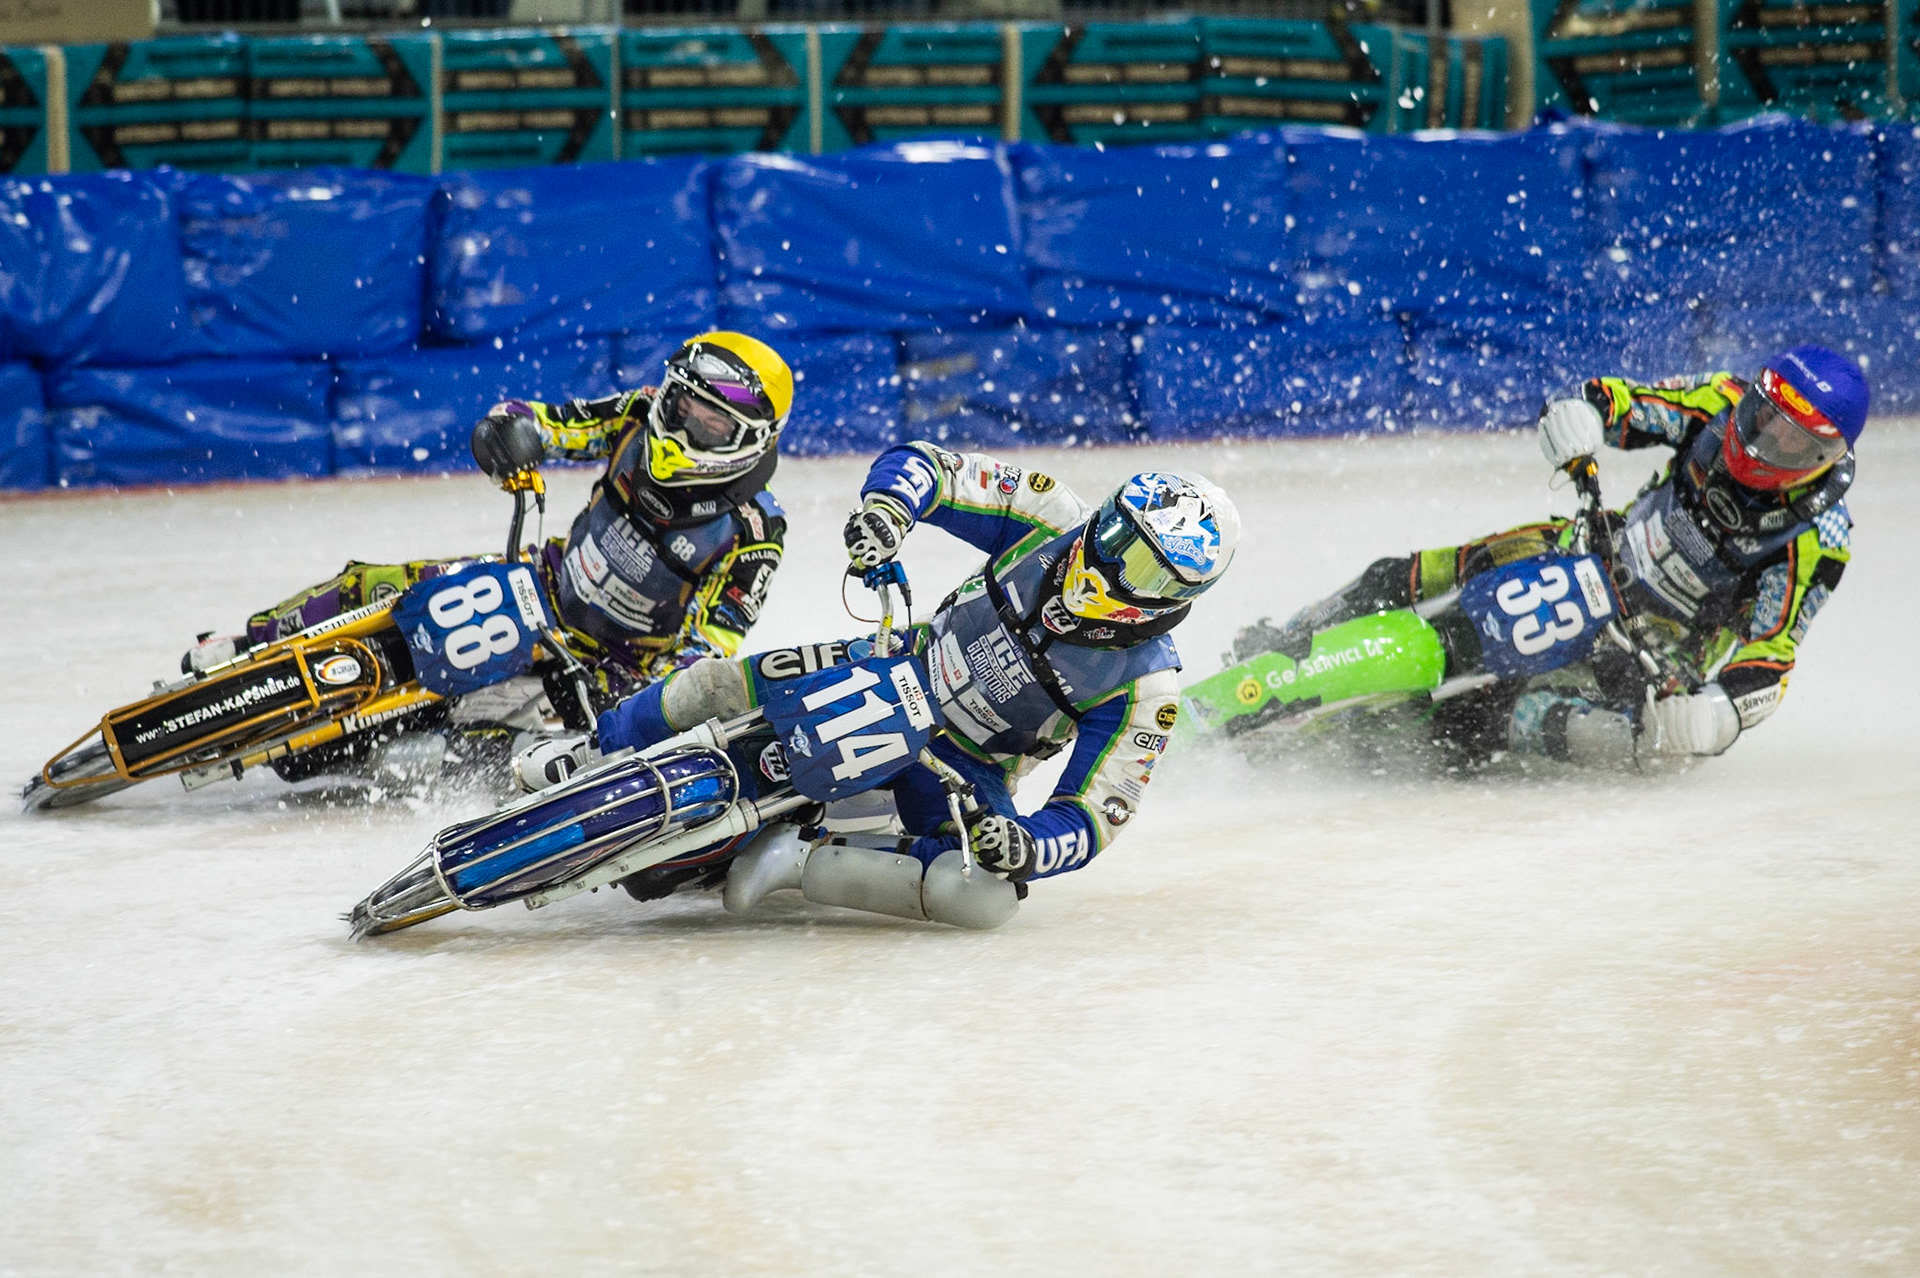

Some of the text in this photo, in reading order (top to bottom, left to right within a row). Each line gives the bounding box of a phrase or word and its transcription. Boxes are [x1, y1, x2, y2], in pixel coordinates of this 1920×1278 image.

[891, 455, 938, 510] UFA
[670, 534, 697, 562] 88
[515, 578, 535, 617] TISSOT
[1048, 602, 1072, 628] 114
[1496, 565, 1585, 656] 33
[428, 574, 521, 671] 88
[985, 625, 1033, 692] ICE
[898, 675, 922, 718] TISSOT
[969, 698, 999, 728] TISSOT
[801, 666, 910, 782] 114
[766, 748, 786, 775] 114
[1034, 828, 1089, 874] UFA
